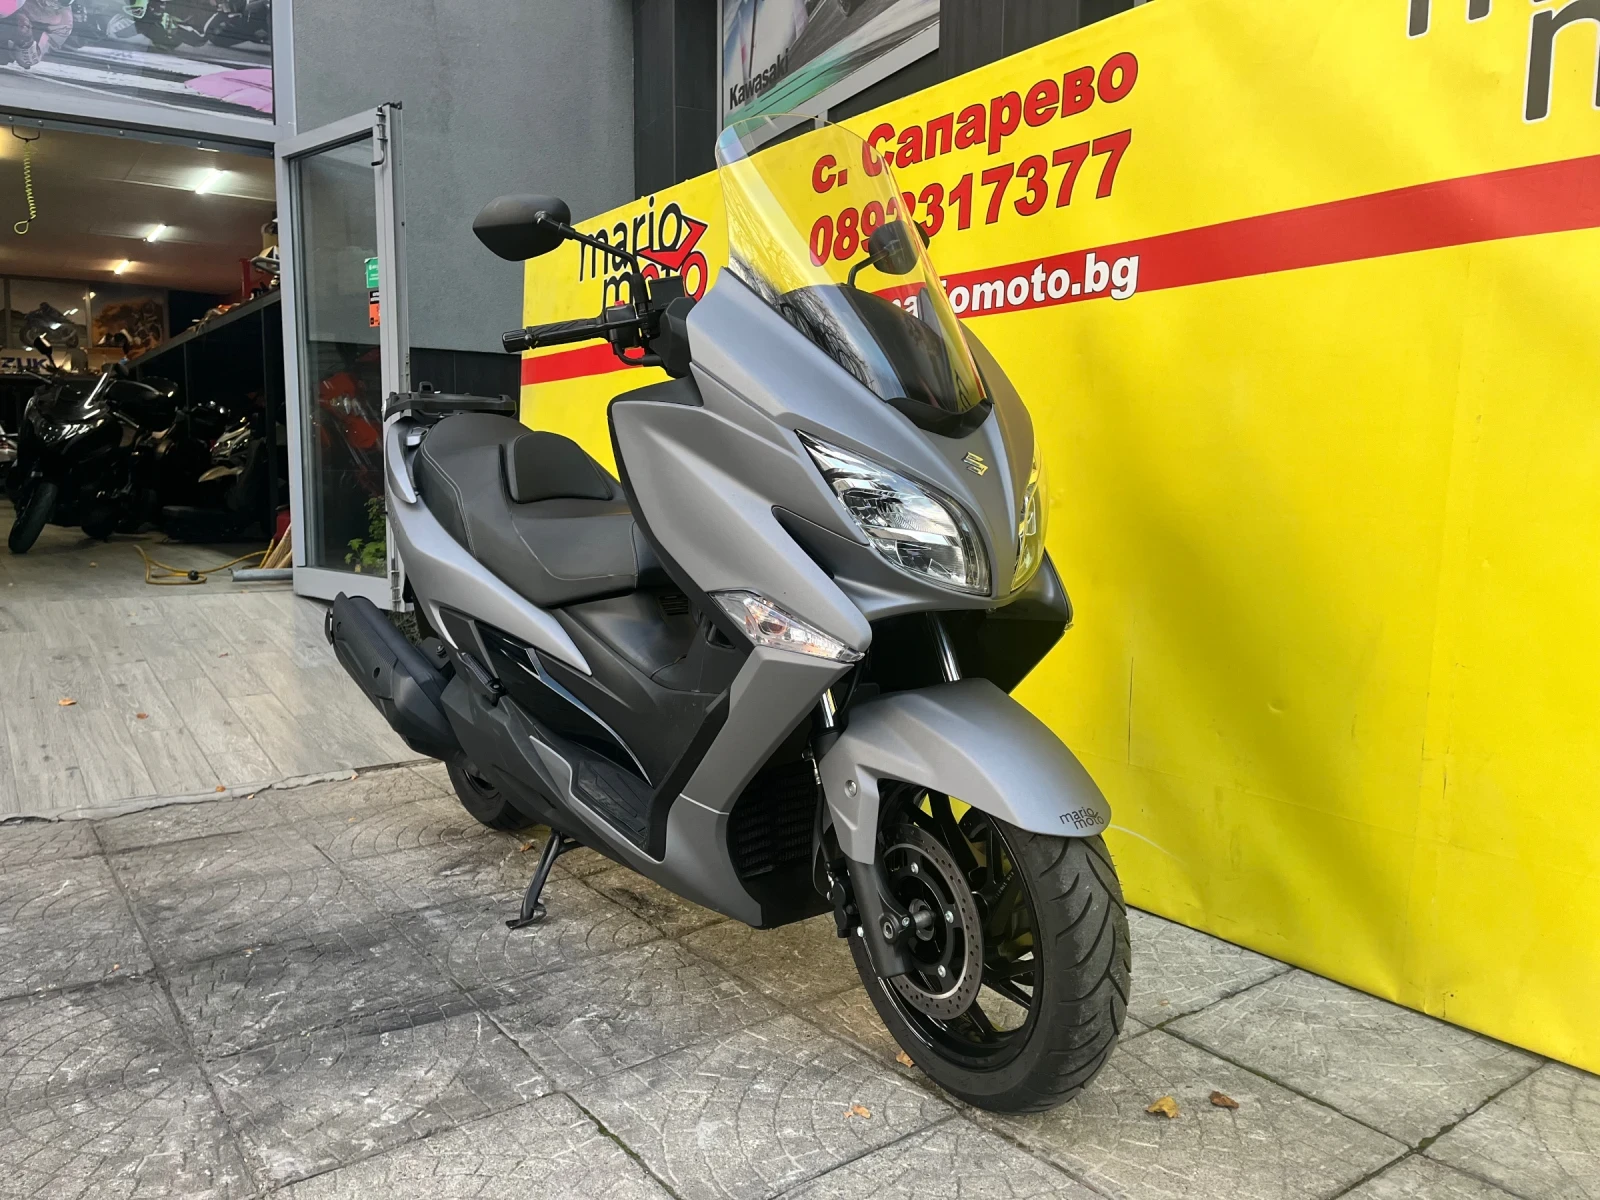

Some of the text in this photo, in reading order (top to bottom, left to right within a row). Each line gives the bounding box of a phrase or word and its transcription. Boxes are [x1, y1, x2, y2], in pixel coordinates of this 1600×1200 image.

[730, 47, 789, 110] Kawasaki
[811, 52, 1138, 193] с. Сапарево
[579, 196, 682, 282] mario
[891, 252, 1140, 318] aomoto.bg
[1059, 806, 1095, 824] mario
[1073, 816, 1105, 830] moto
